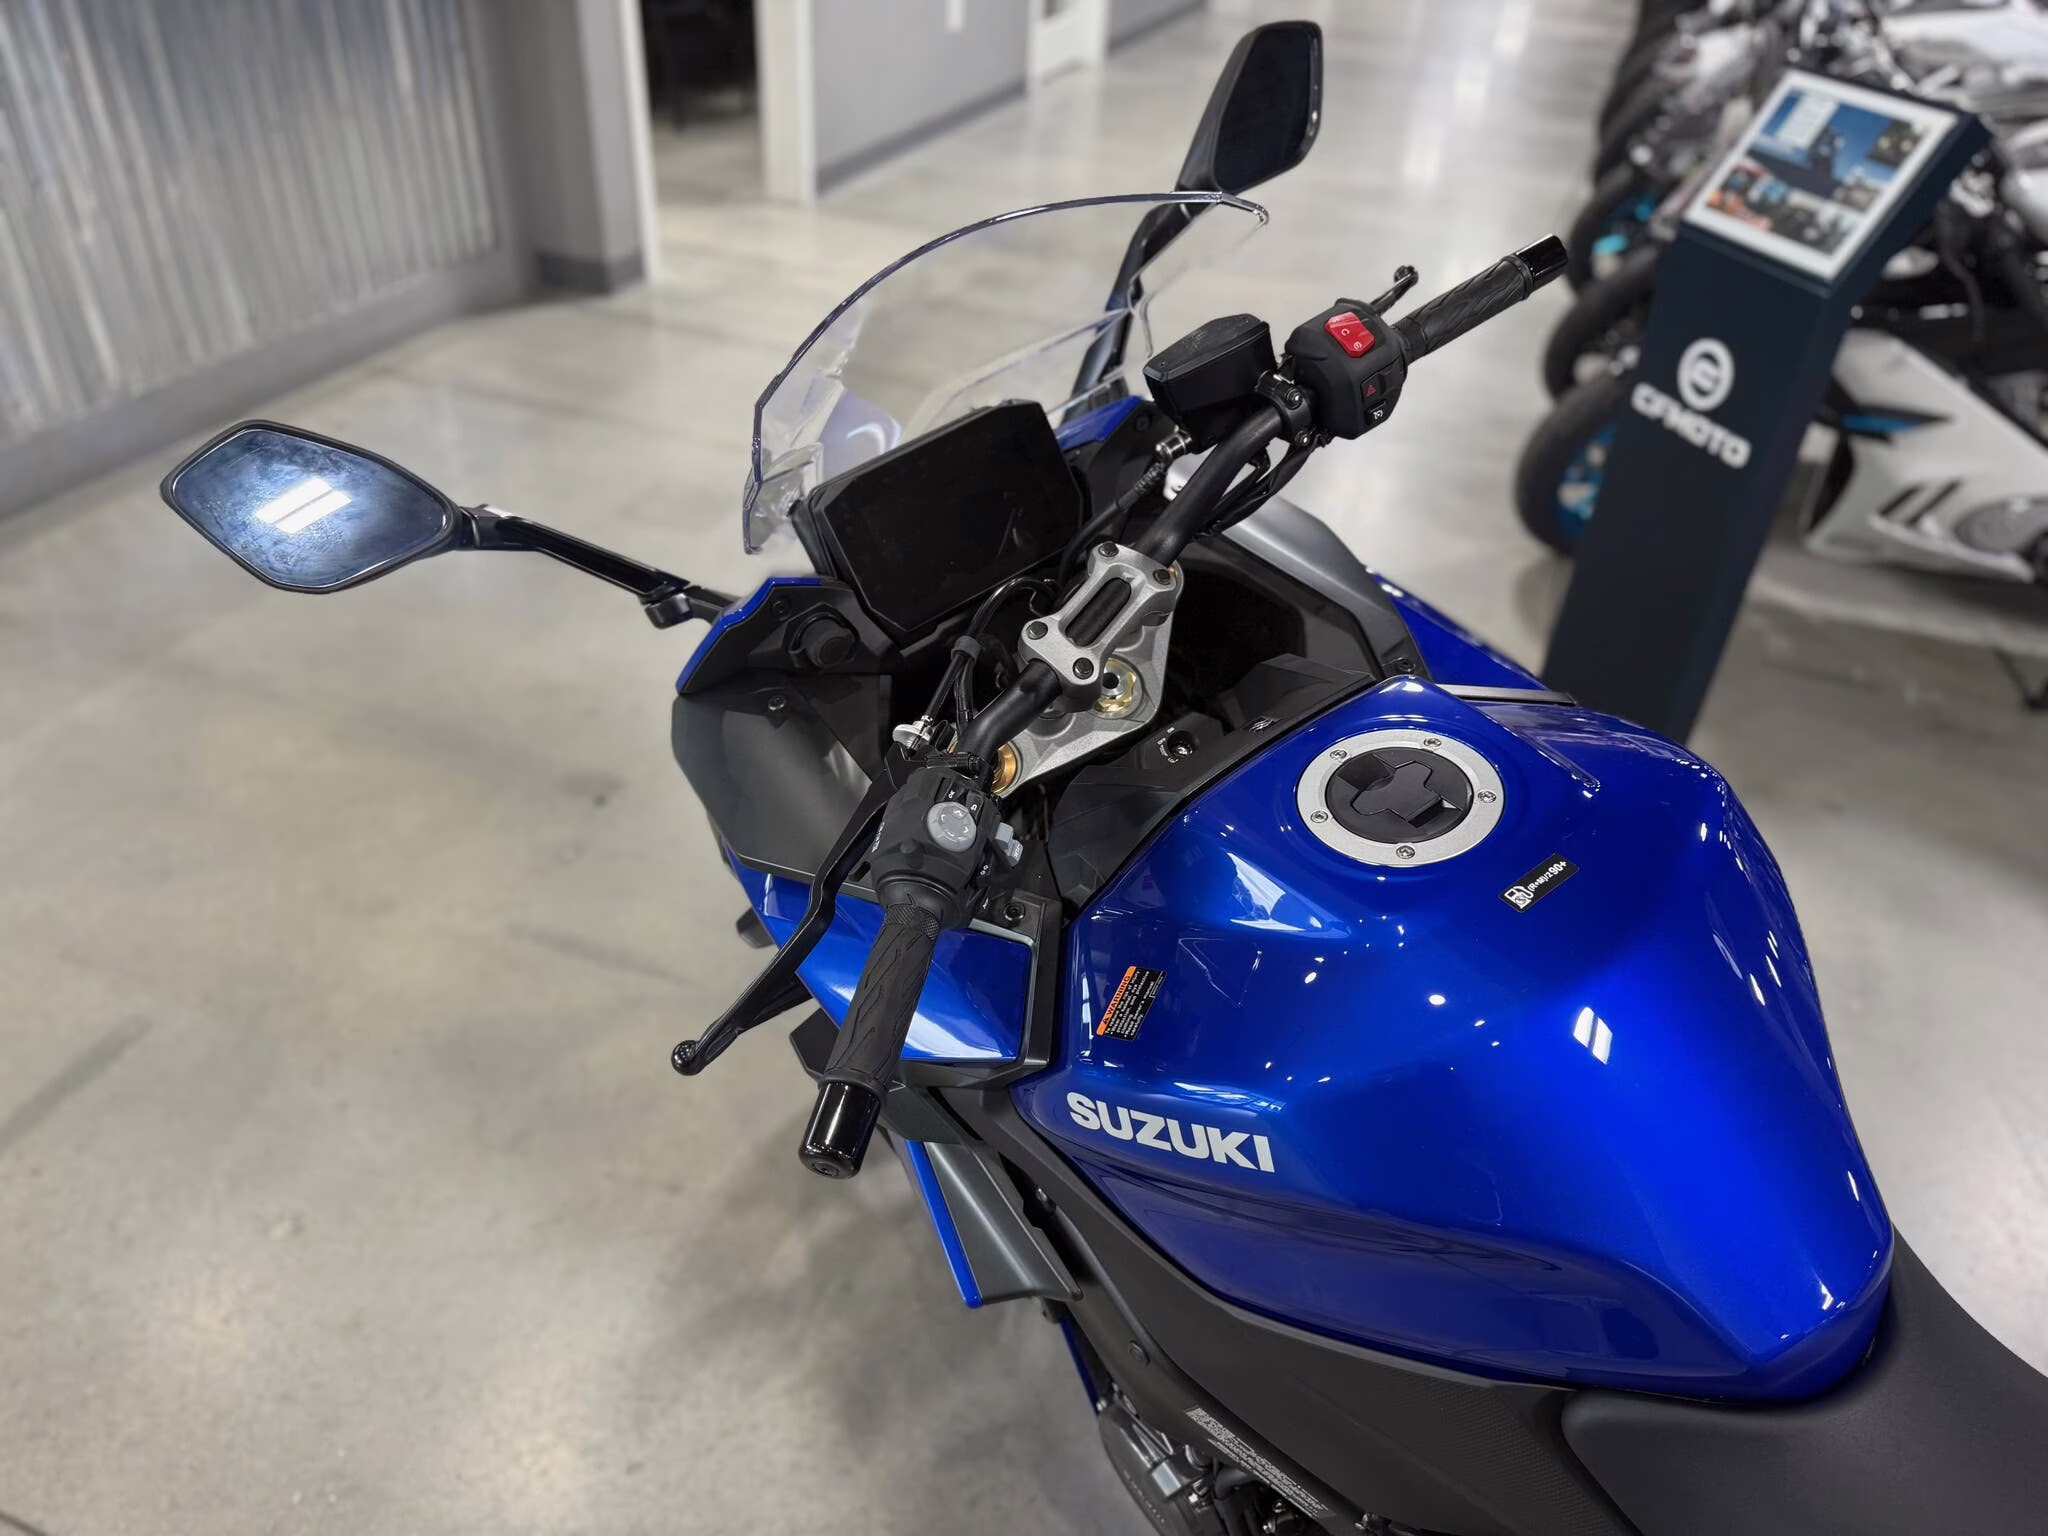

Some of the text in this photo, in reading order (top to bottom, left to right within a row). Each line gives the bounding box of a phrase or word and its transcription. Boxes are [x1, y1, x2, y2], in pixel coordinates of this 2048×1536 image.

[1630, 382, 1751, 468] CFMOTO
[1548, 860, 1567, 875] 90+
[1108, 976, 1130, 1014] WARNING
[1066, 1091, 1275, 1173] SUZUKI
